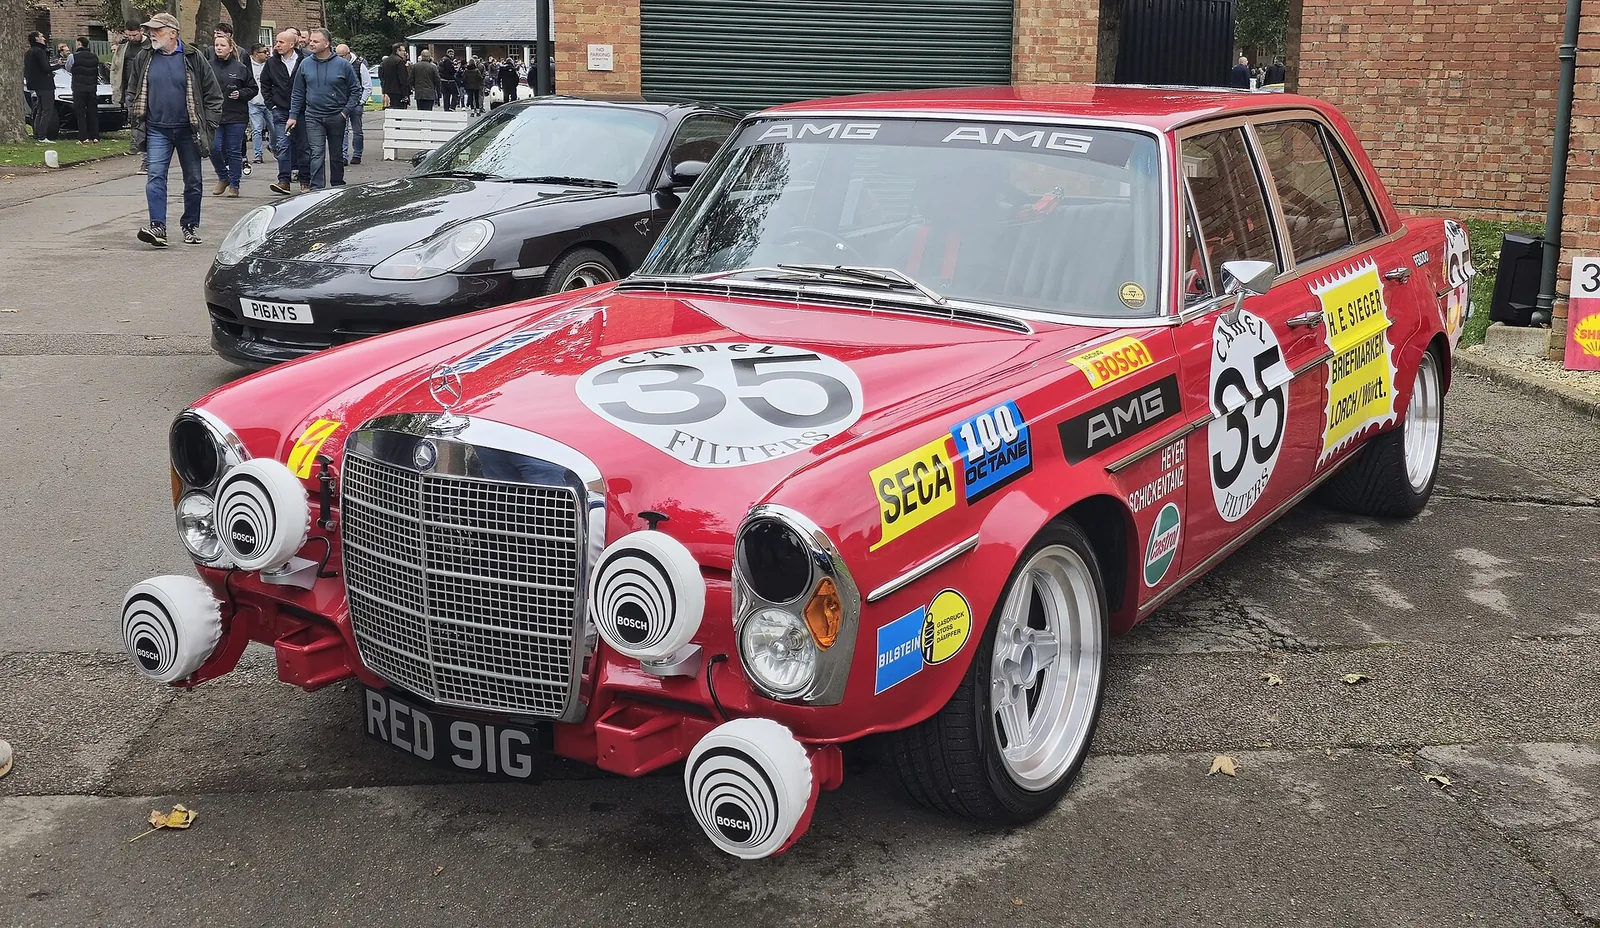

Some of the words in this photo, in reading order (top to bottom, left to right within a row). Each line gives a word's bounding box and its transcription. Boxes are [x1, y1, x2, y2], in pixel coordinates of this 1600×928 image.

[756, 123, 882, 141] AMG
[940, 130, 1094, 154] AMG
[1327, 312, 1338, 337] H.
[1338, 307, 1348, 332] E.
[1347, 289, 1382, 327] SIEGER
[1091, 342, 1149, 381] BOSCH
[1331, 332, 1384, 385] BRIEFMARKEN
[592, 354, 853, 428] 35
[960, 405, 1020, 464] 100
[1087, 388, 1165, 449] AMG
[1212, 344, 1285, 489] 35
[664, 429, 830, 465] FILTERS
[965, 440, 1027, 486] OCTANE
[1161, 439, 1185, 472] HEYER
[878, 454, 952, 524] SECA
[1129, 464, 1185, 513] SCHICKENTANZ
[1221, 467, 1269, 518] FILTERS
[232, 531, 255, 544] BOSCH
[1149, 525, 1180, 561] Castrol
[617, 615, 648, 631] BOSCH
[936, 611, 965, 628] GASDRUCK
[936, 623, 953, 636] STOSS
[137, 648, 159, 661] BOSCH
[878, 635, 920, 669] BILSTEIN
[365, 688, 434, 761] RED
[450, 720, 532, 778] 91G
[716, 815, 750, 831] BOSCH
